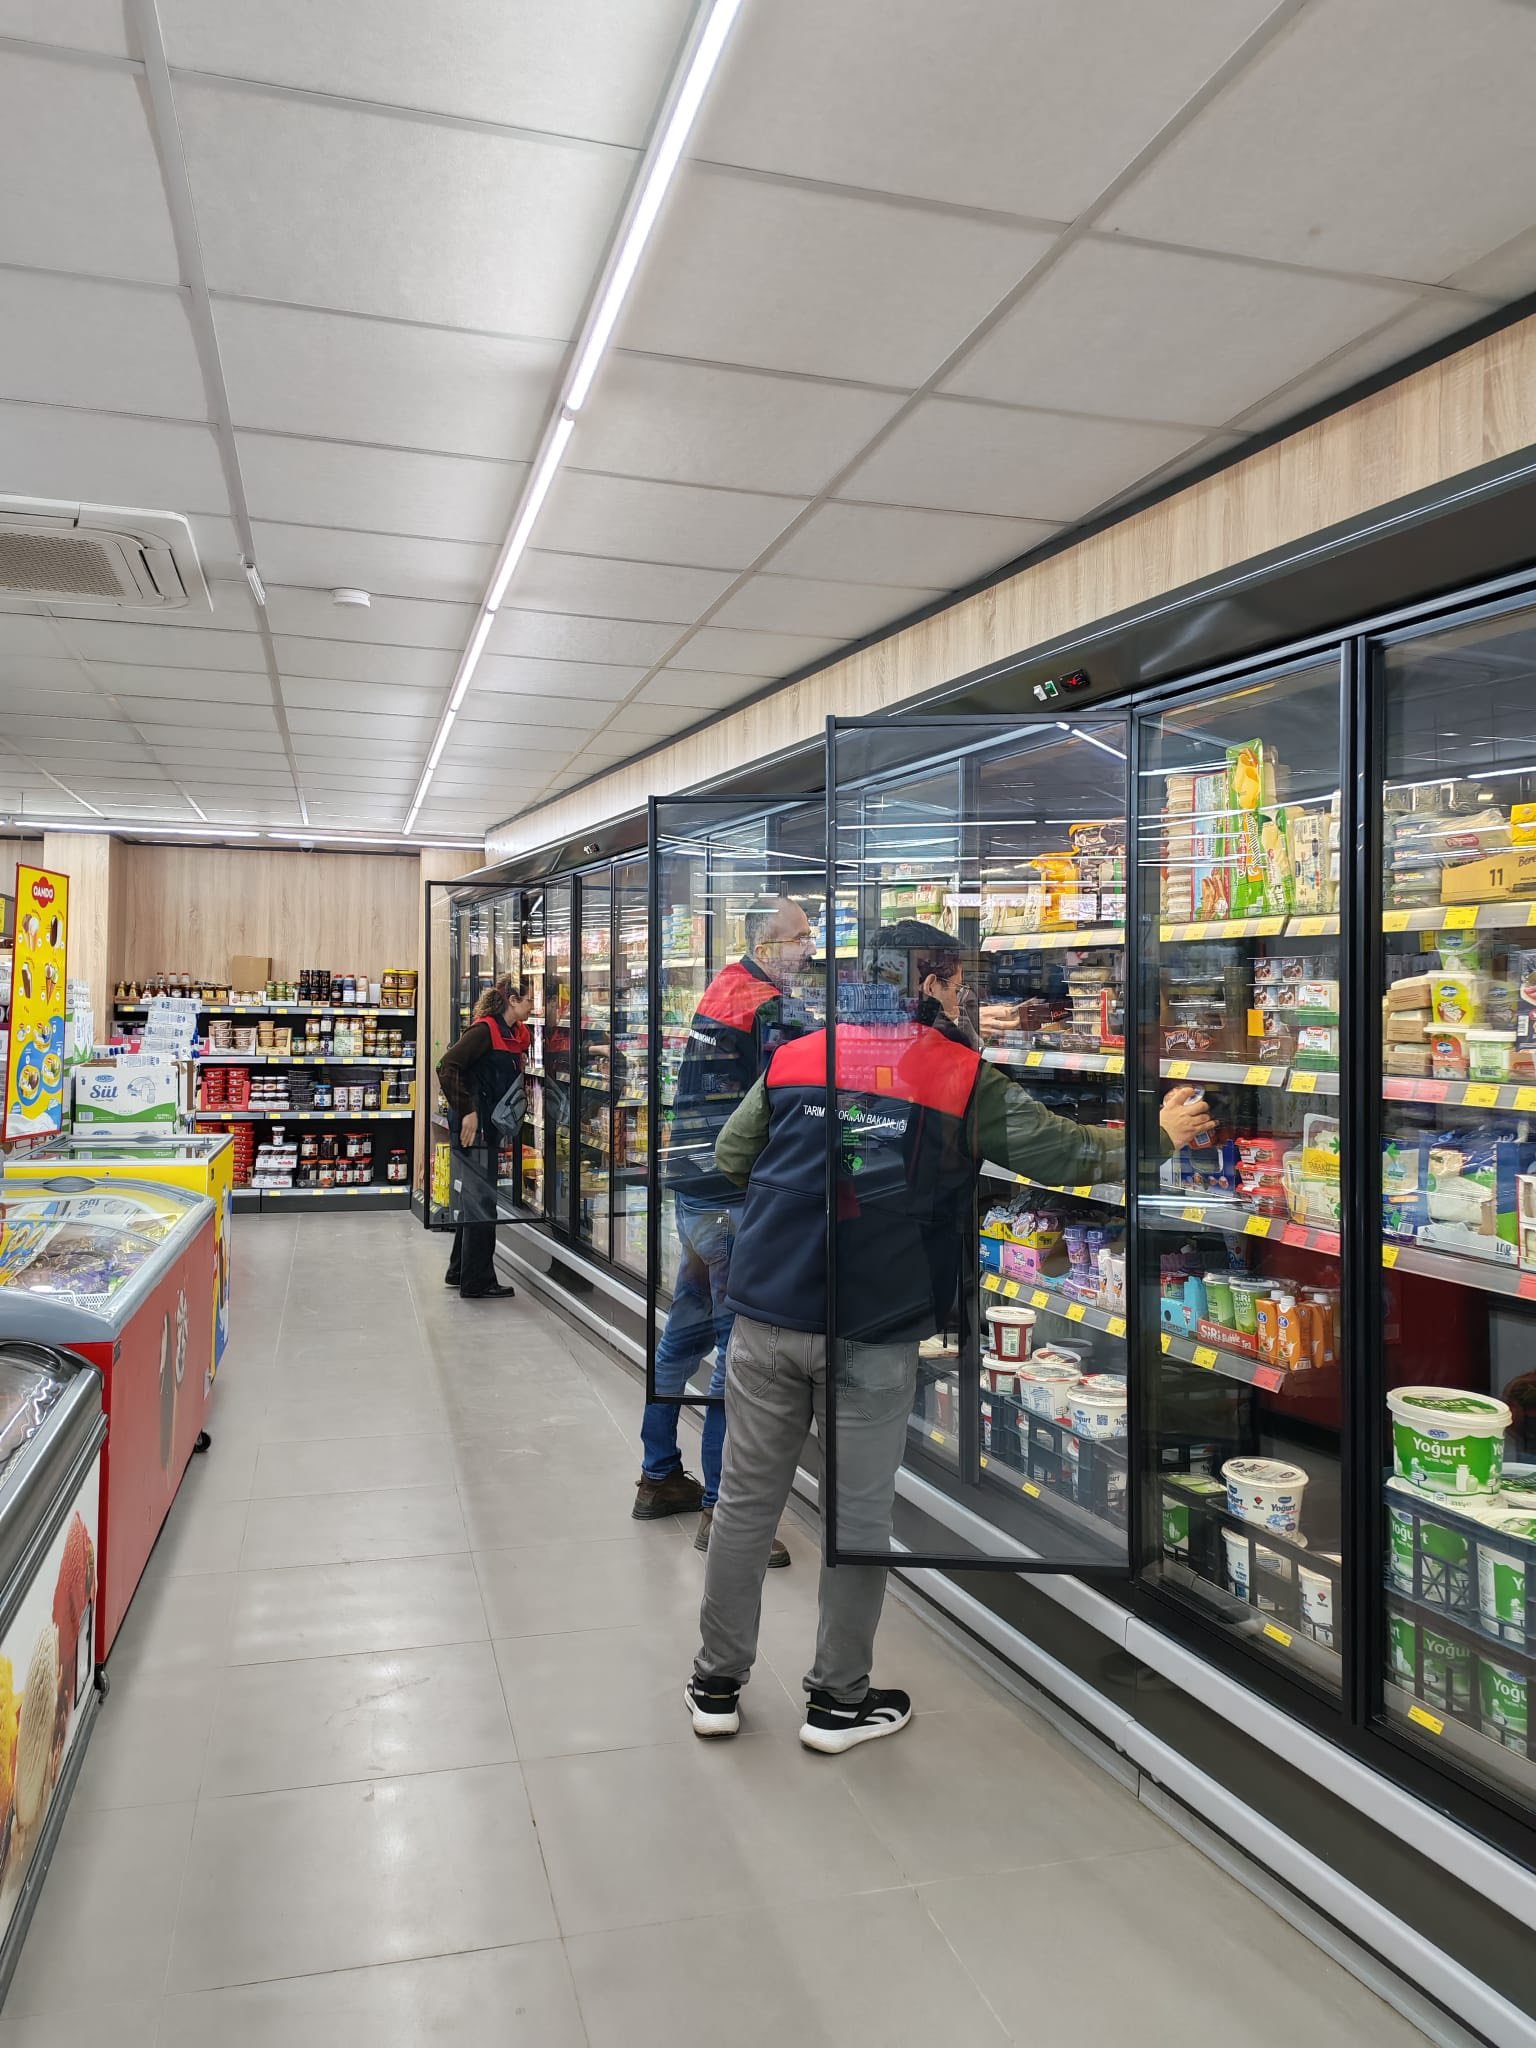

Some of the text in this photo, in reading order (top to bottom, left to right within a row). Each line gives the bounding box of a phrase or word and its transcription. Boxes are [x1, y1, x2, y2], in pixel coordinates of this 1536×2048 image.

[1490, 868, 1503, 886] 11
[90, 1085, 119, 1099] Süt
[803, 1104, 826, 1118] TARIM
[1413, 1437, 1466, 1458] Yoğurt
